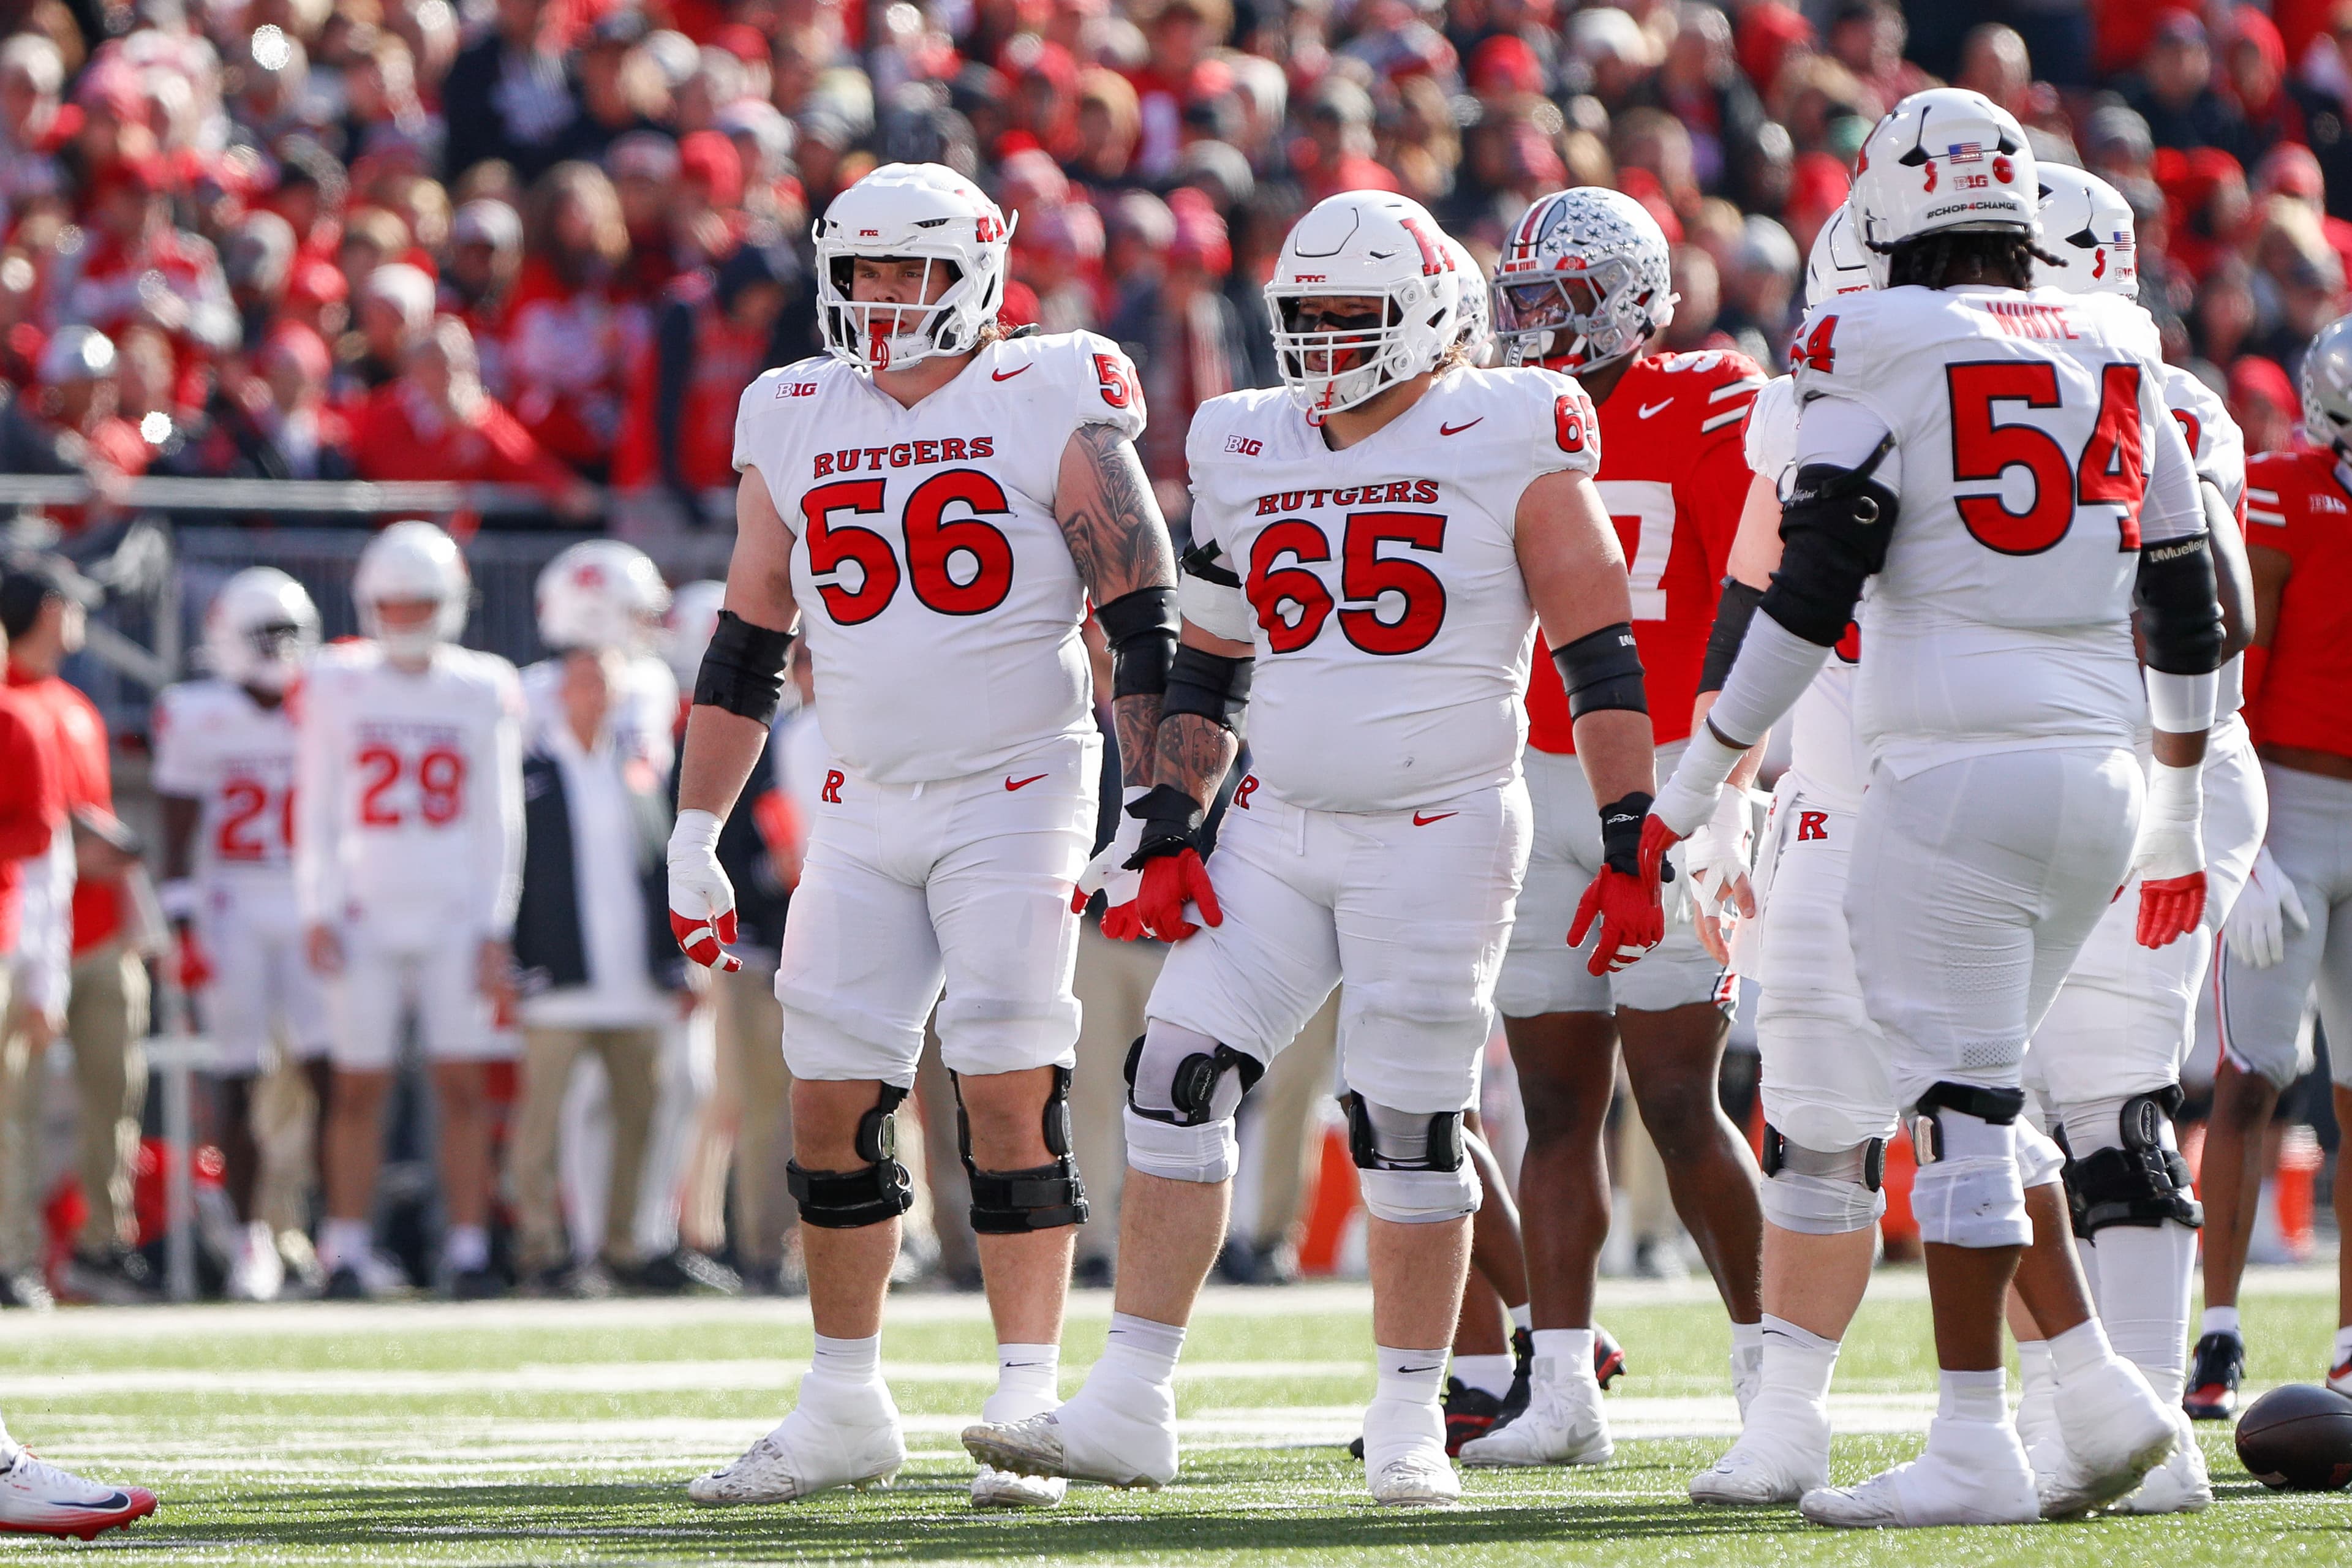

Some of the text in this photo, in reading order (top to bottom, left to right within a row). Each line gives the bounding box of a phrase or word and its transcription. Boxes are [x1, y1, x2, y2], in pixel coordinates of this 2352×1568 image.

[1927, 202, 2018, 219] #CHOP4CHANGE
[1986, 301, 2080, 339] WHITE
[813, 436, 994, 480] RUTGERS
[1945, 360, 2152, 556] 54
[1255, 479, 1439, 516] RUTGERS
[801, 468, 1014, 626] 56
[1245, 511, 1448, 655] 65
[822, 769, 845, 804] R
[1234, 774, 1260, 810] R
[1798, 811, 1828, 841] R
